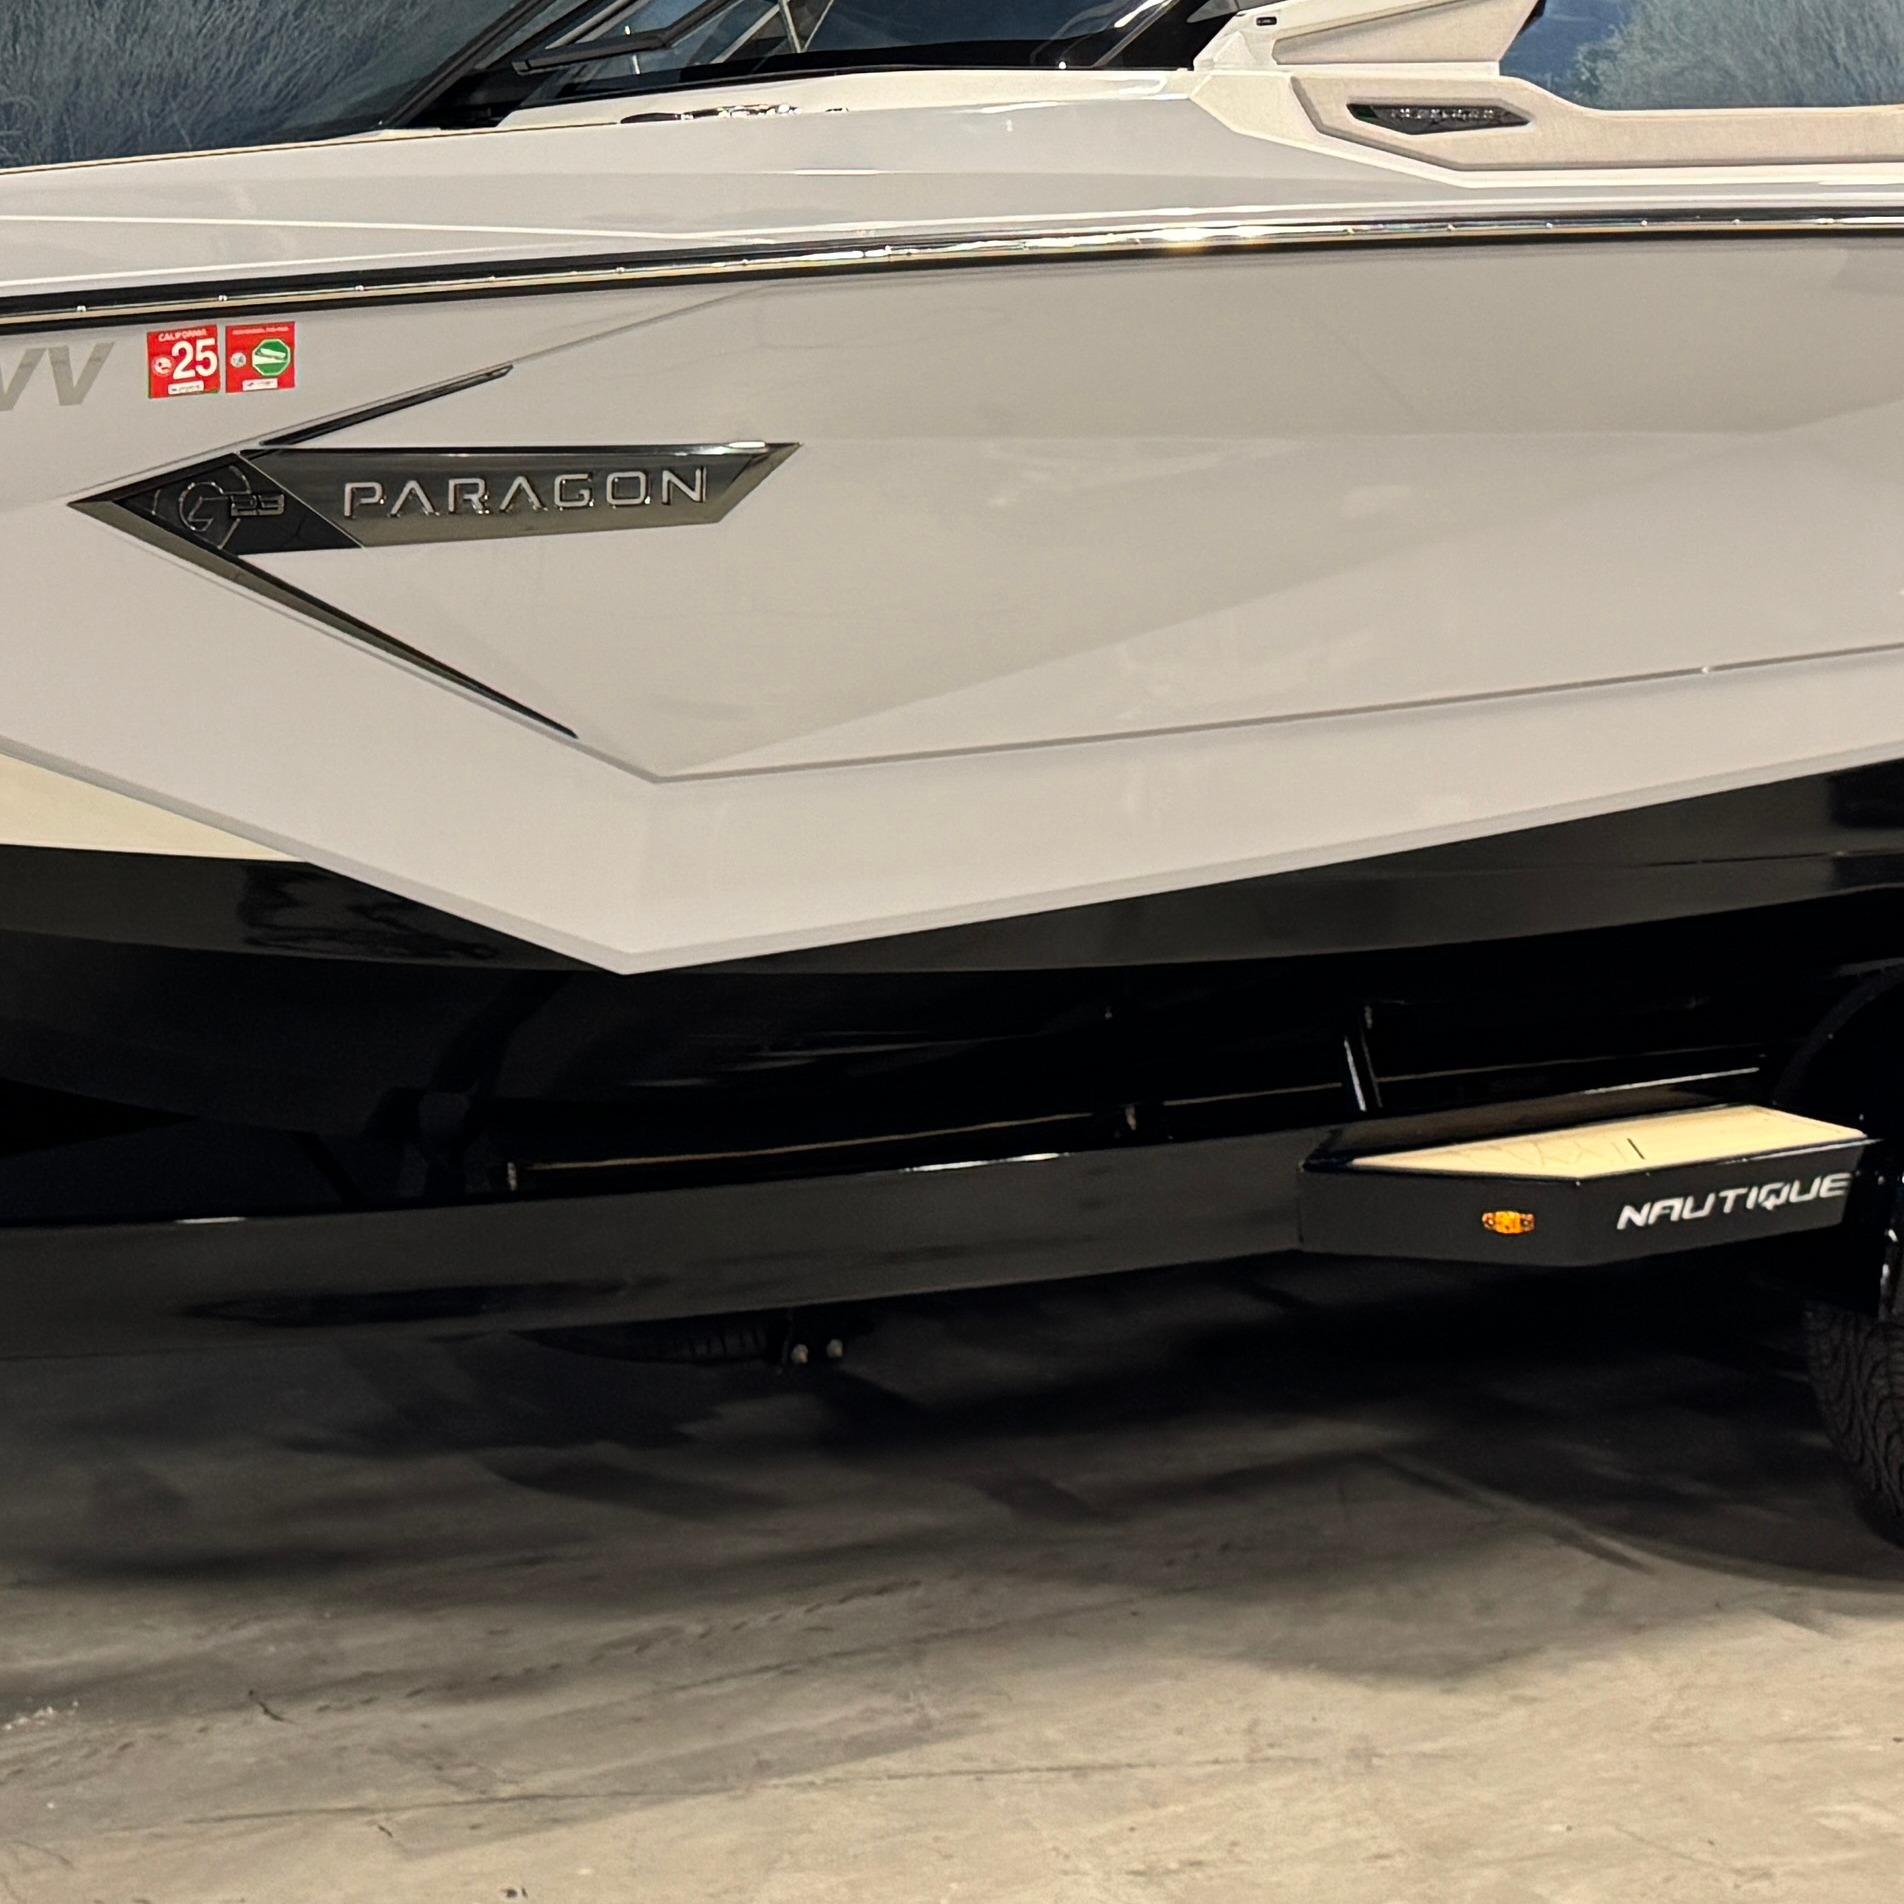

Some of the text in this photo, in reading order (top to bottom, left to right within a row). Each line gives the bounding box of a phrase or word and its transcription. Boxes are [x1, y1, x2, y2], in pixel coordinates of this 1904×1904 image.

[171, 337, 218, 380] 25
[343, 466, 709, 519] PARAGON
[1616, 1171, 1854, 1231] NAUTIQUE
